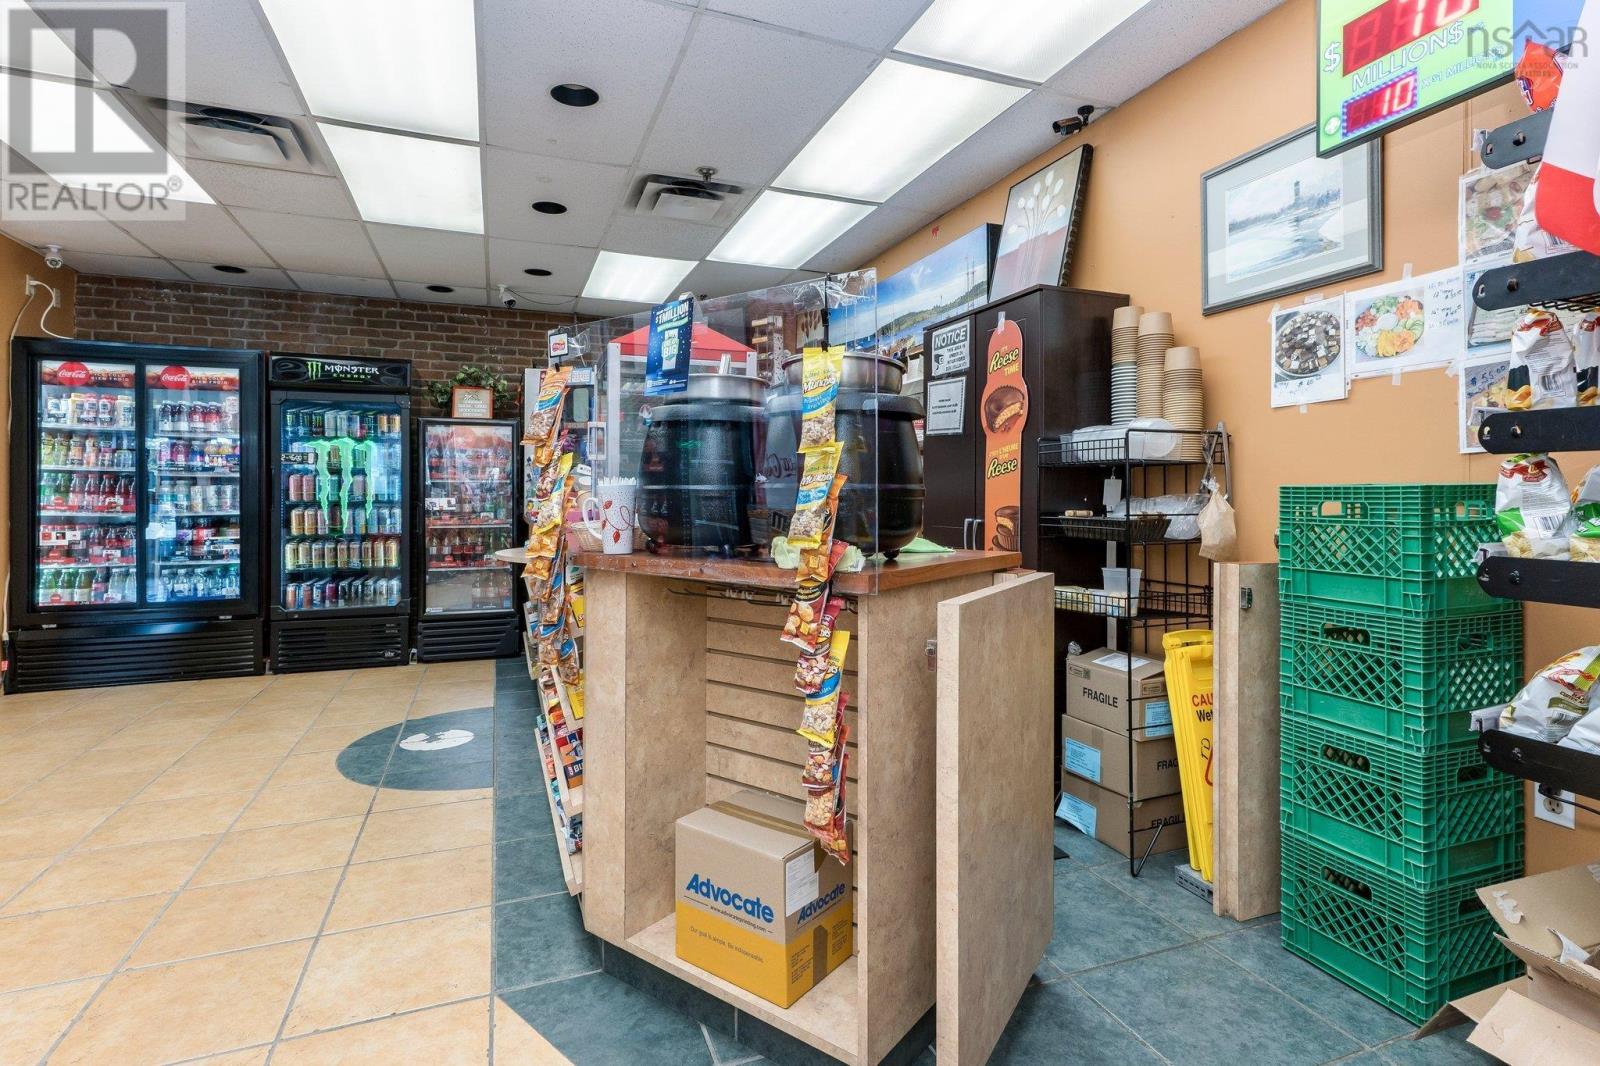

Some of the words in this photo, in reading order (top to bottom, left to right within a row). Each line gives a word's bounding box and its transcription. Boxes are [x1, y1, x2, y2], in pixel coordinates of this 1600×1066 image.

[935, 327, 966, 348] NOTICE
[324, 364, 380, 375] MONSTER
[990, 348, 1019, 374] Reese
[1004, 362, 1020, 377] TIME
[987, 457, 1017, 479] Reese
[1083, 687, 1118, 708] FRAGILE
[686, 873, 774, 923] Advocate
[798, 882, 846, 925] Advocate
